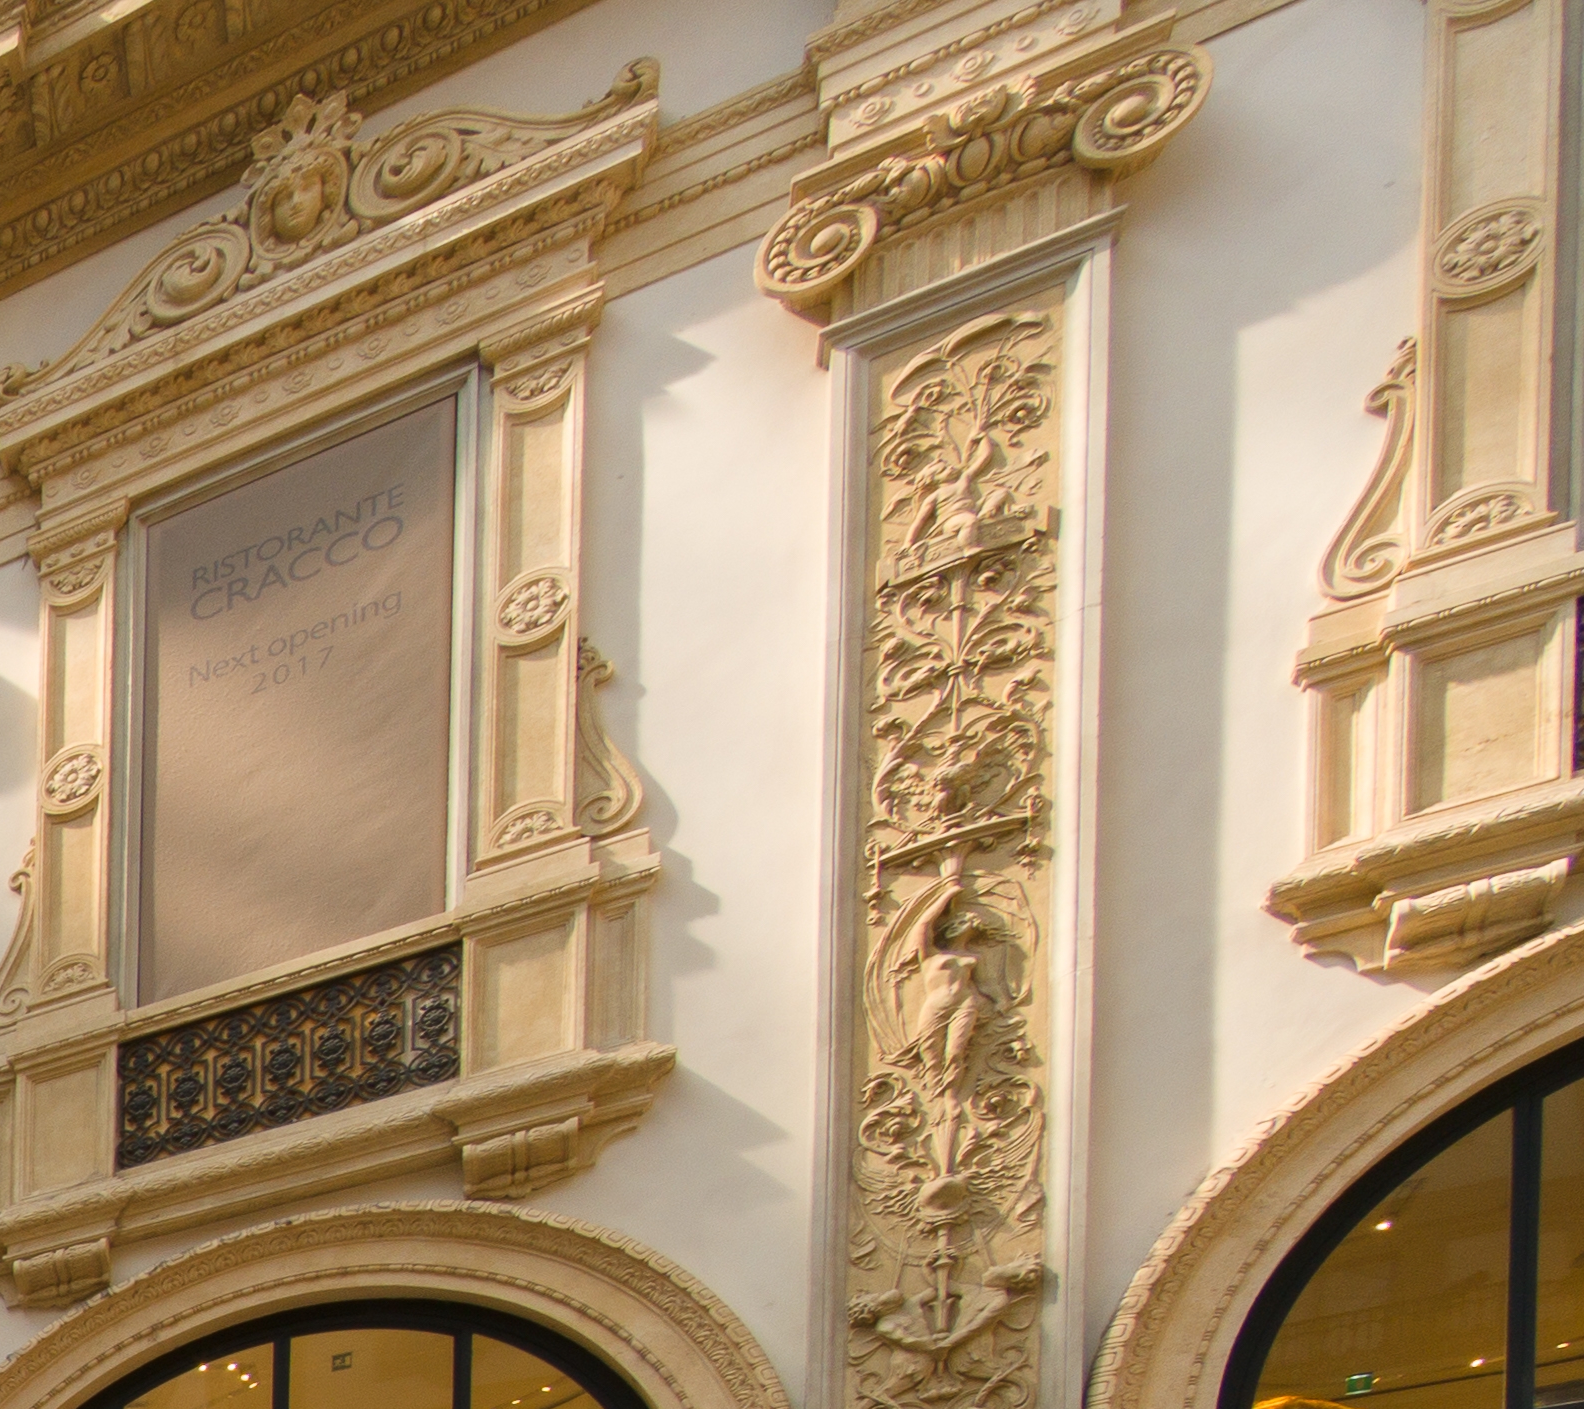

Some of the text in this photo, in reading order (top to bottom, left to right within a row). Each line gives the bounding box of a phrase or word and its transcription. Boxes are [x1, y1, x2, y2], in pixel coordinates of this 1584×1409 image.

[190, 516, 404, 620] CRACCO
[191, 483, 405, 590] RISTORANTE
[189, 591, 403, 687] Next opening
[251, 646, 334, 694] 2017
